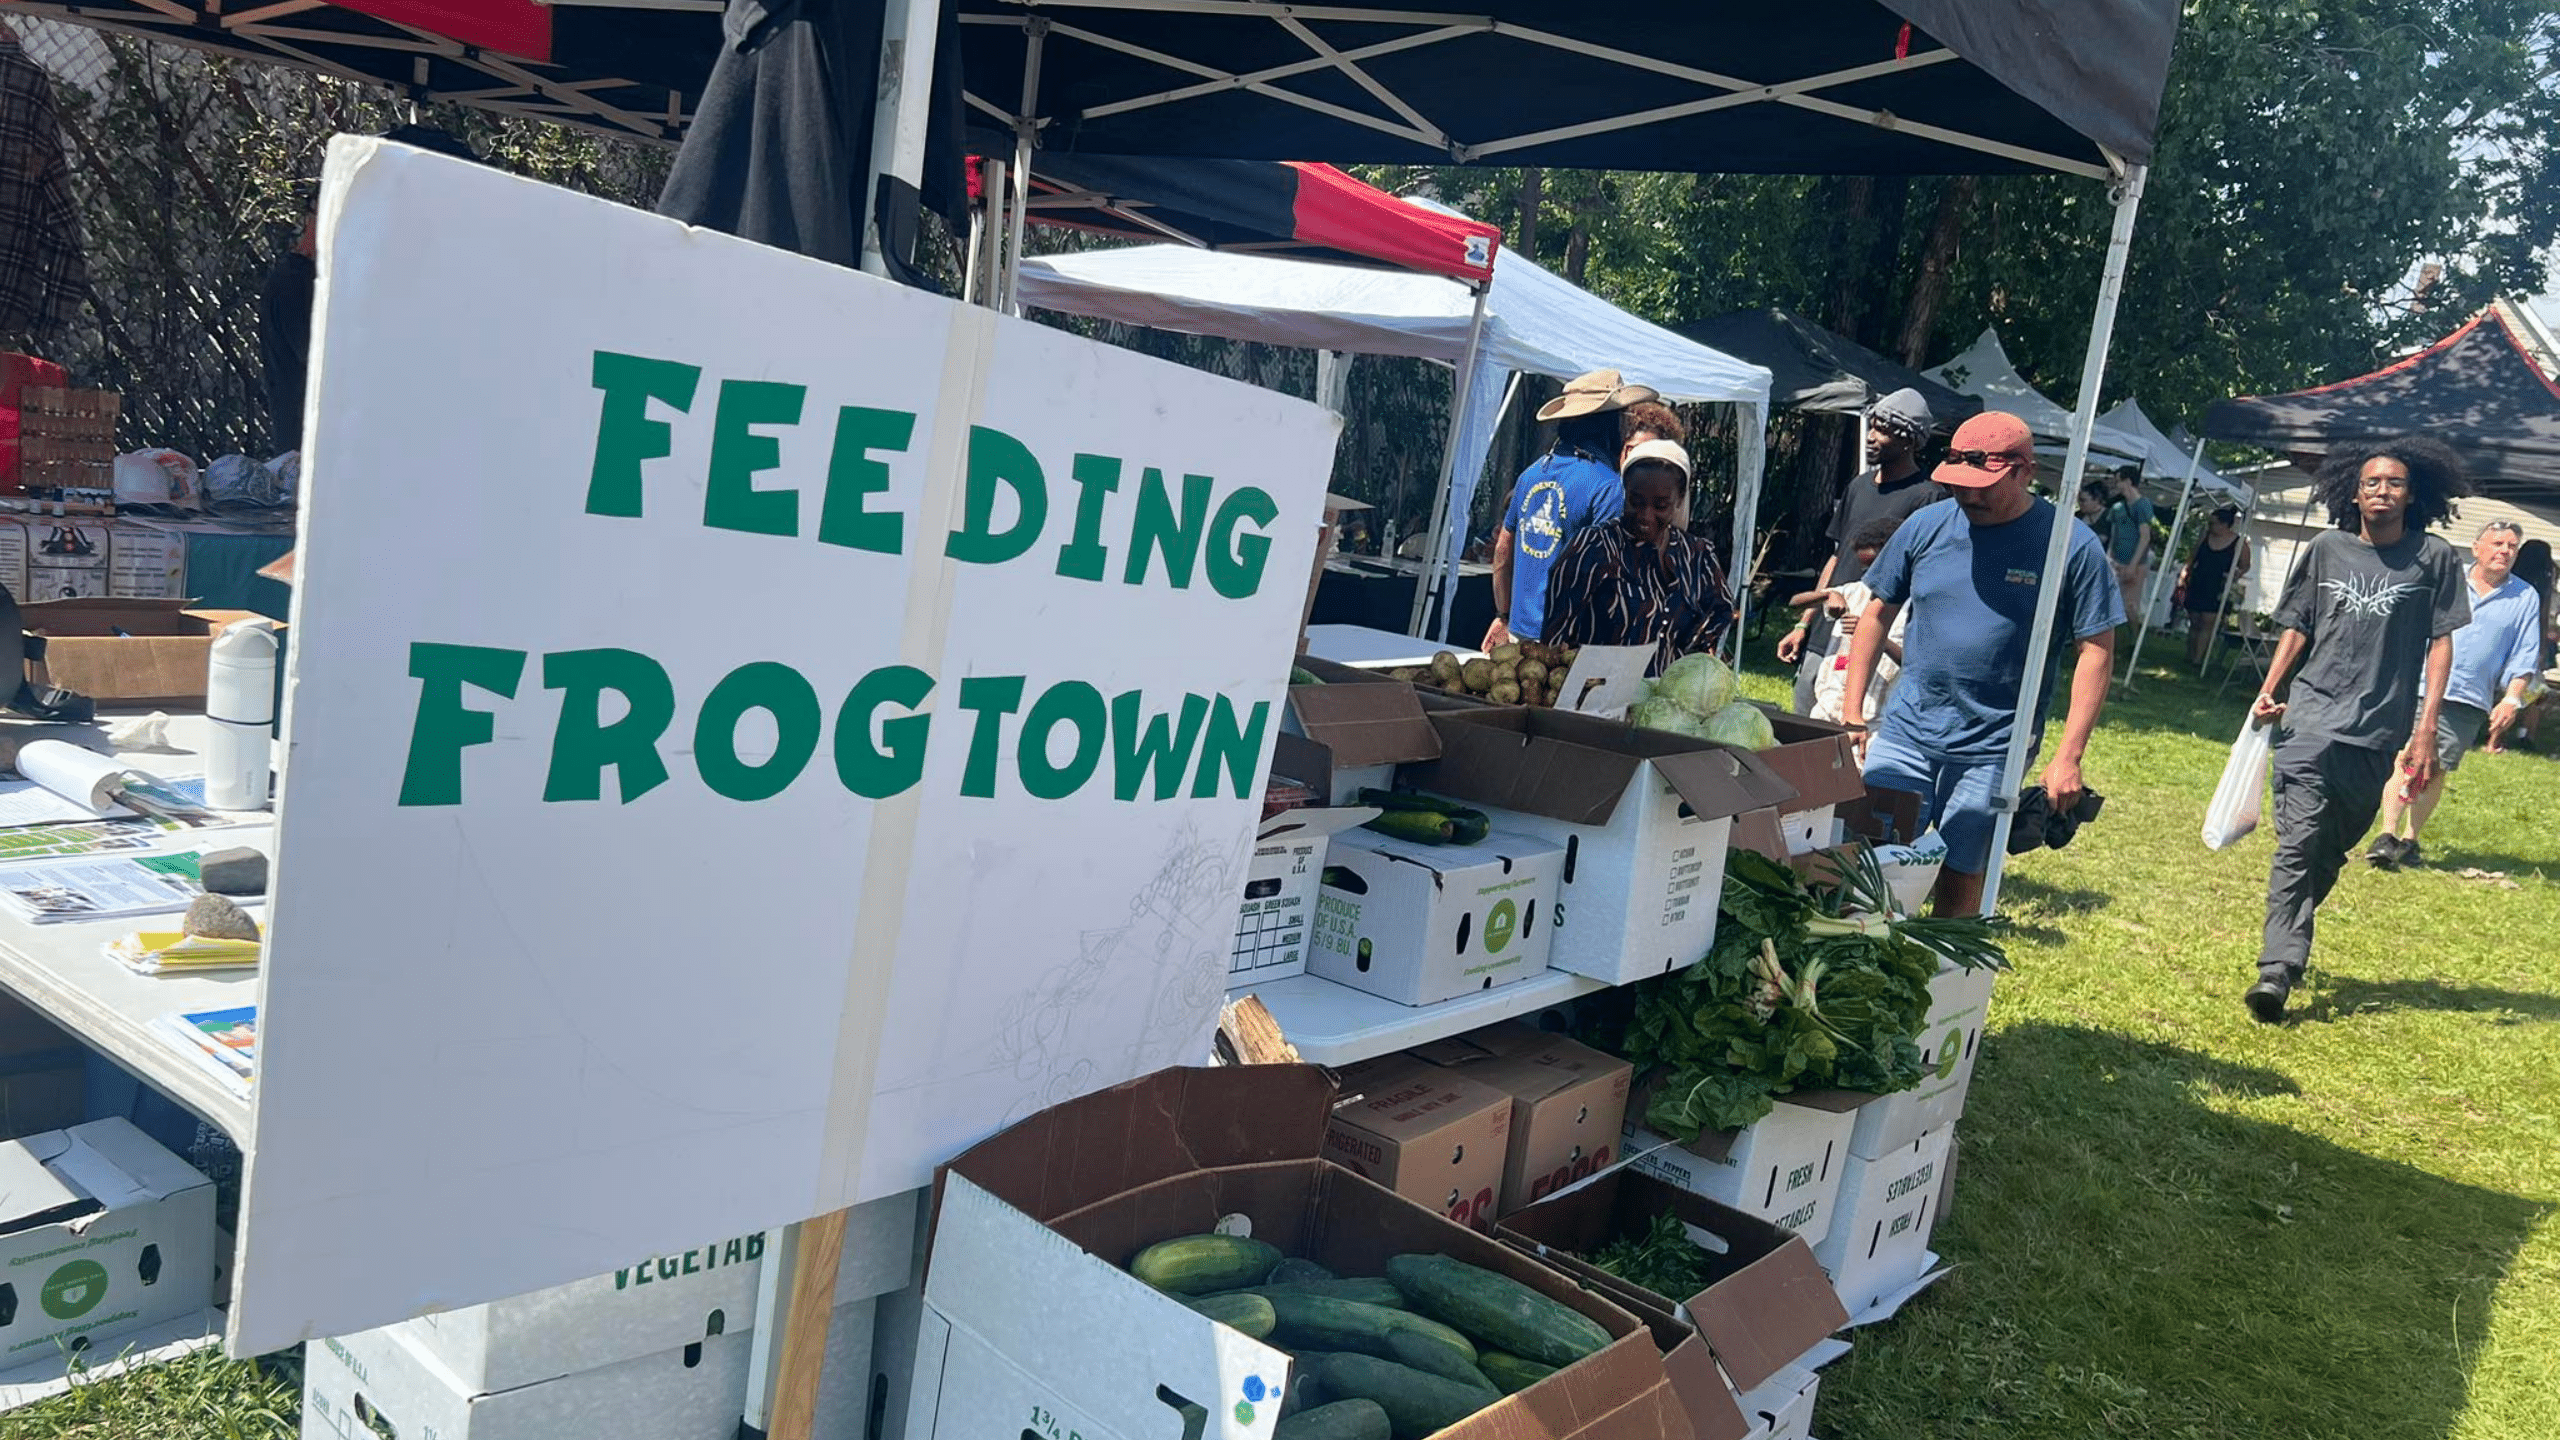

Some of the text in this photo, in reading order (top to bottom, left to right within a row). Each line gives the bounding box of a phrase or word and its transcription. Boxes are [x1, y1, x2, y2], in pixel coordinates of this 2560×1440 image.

[586, 351, 1279, 599] FEEDING
[399, 641, 1270, 807] FROGTOWN
[1316, 912, 1329, 928] OF
[1319, 894, 1362, 921] PRODUCE
[1786, 1161, 1815, 1193] FRESH
[1885, 1160, 1934, 1204] VEGETABLES
[1888, 1210, 1914, 1239] FRESH
